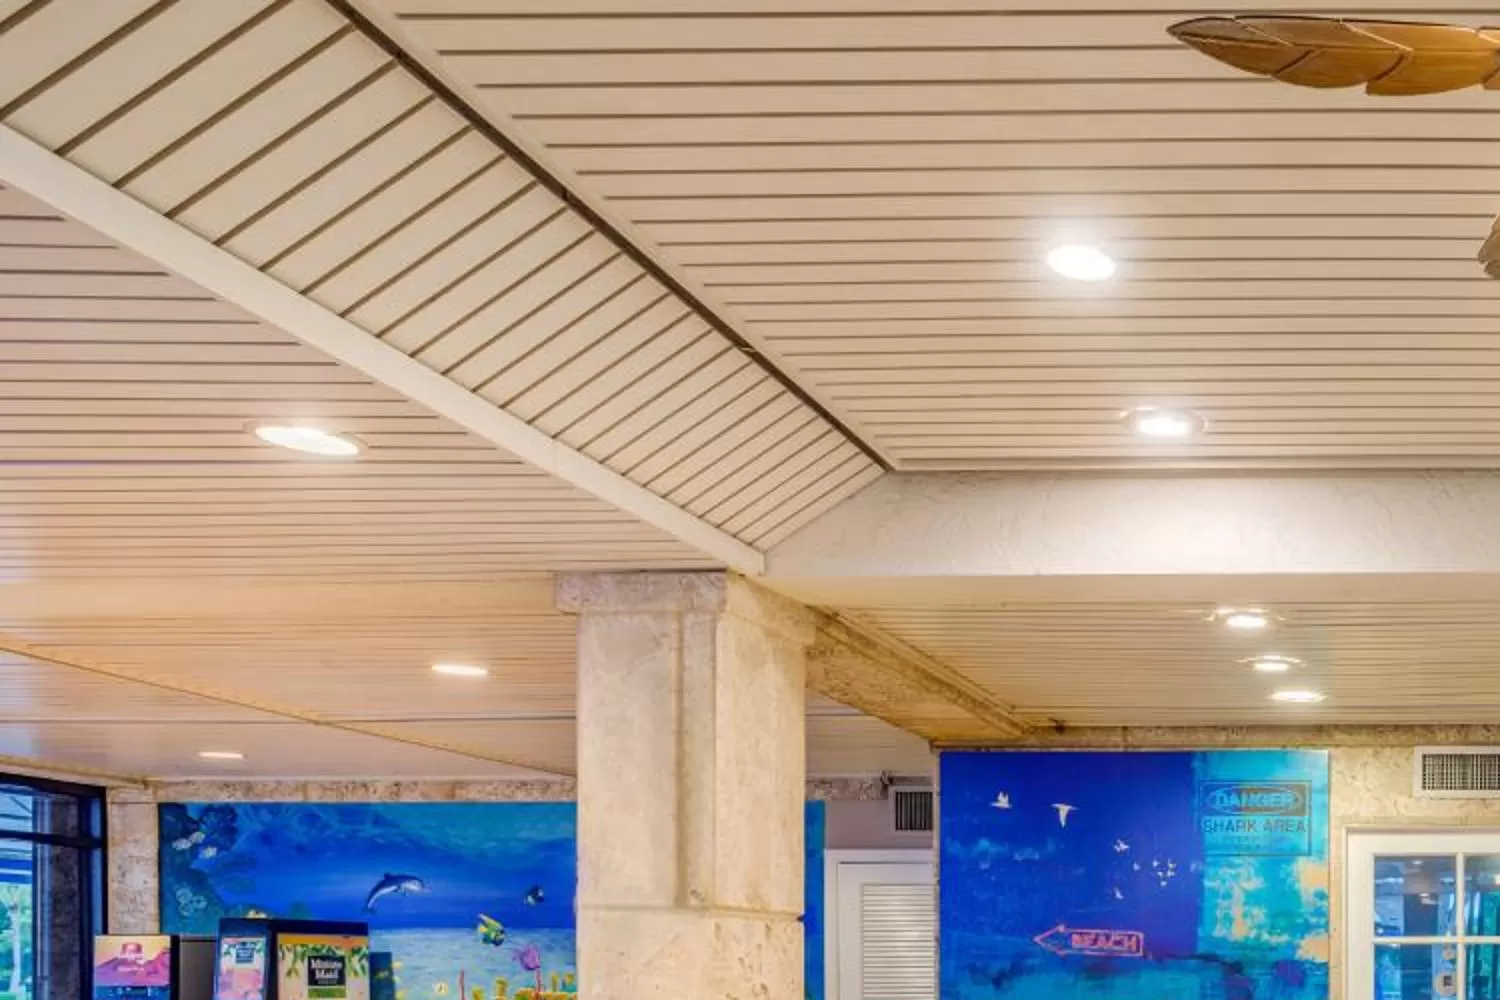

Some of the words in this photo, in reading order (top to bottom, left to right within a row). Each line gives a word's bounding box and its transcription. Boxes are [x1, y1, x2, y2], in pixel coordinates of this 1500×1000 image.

[1203, 819, 1257, 832] SHARK
[1263, 819, 1306, 832] AREA
[1072, 933, 1137, 952] BEACH
